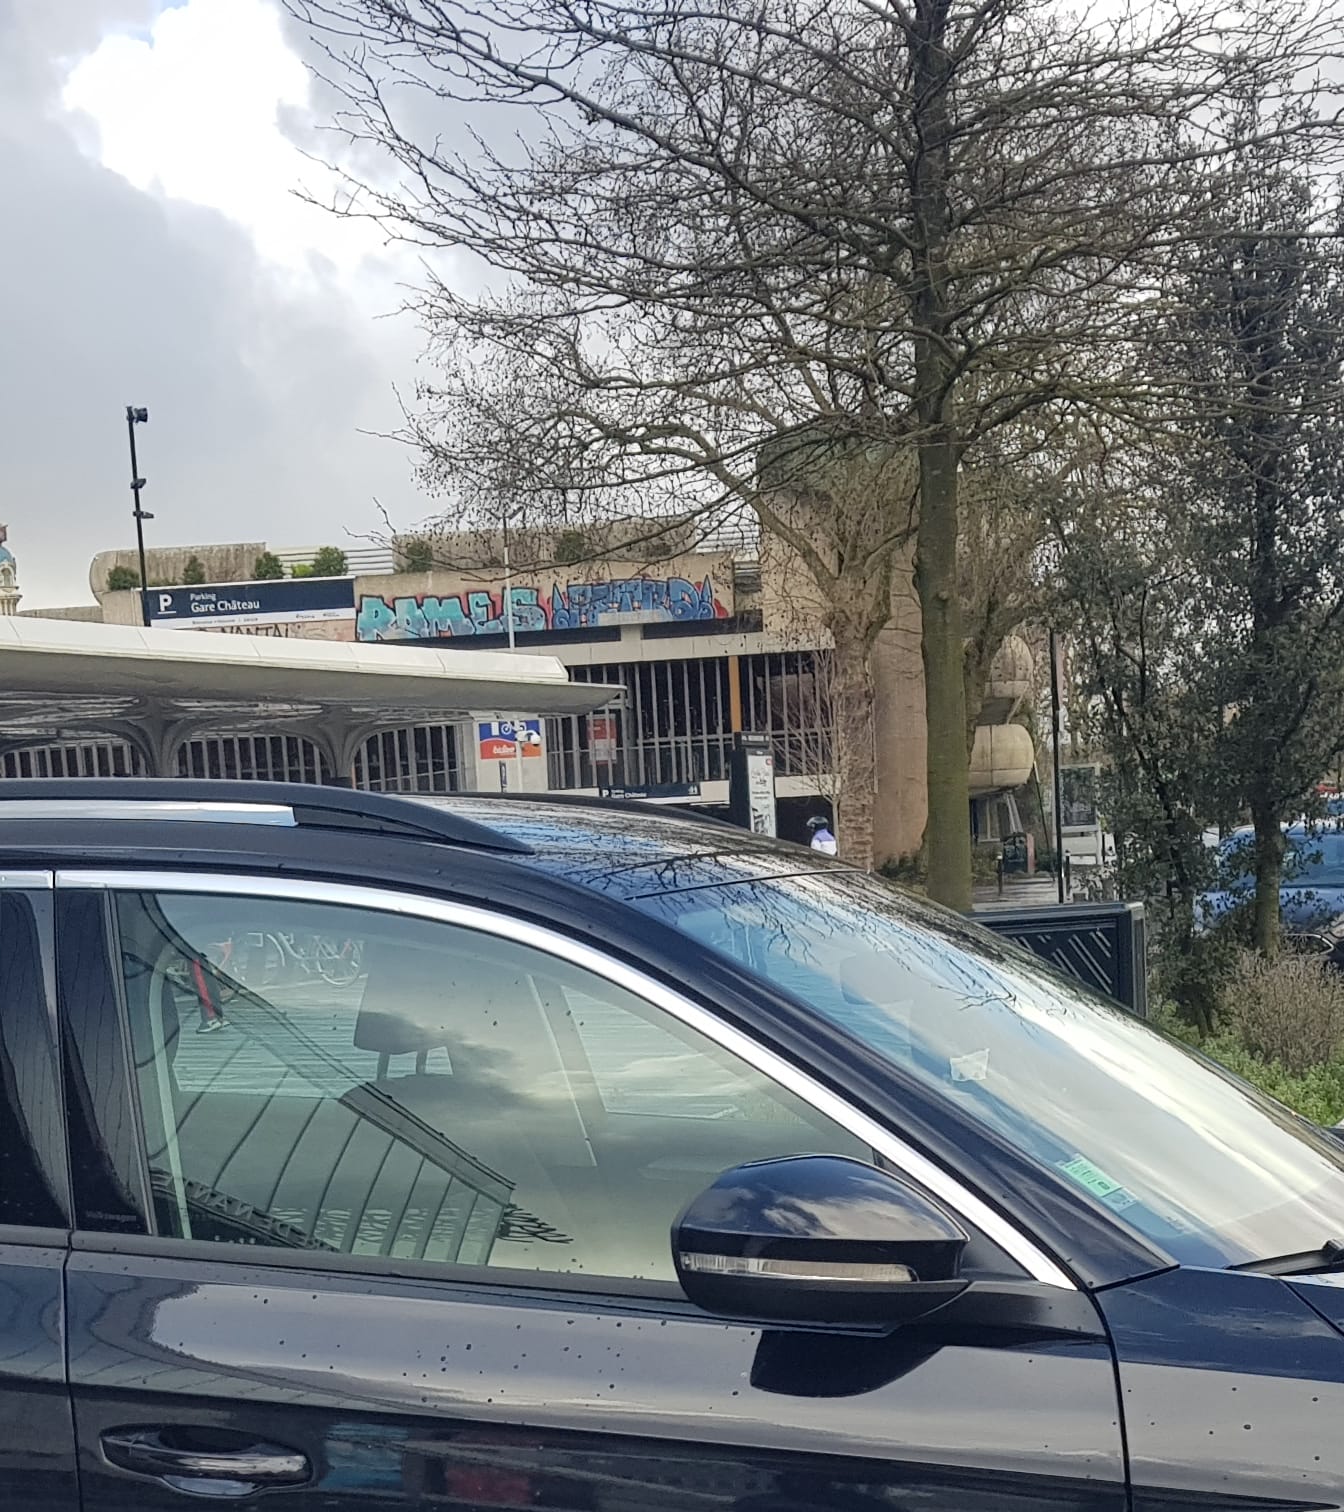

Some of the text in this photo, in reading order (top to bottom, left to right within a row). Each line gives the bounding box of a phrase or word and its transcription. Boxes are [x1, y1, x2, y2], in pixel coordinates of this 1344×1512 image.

[190, 593, 217, 602] Parking
[191, 599, 260, 613] Gare Château
